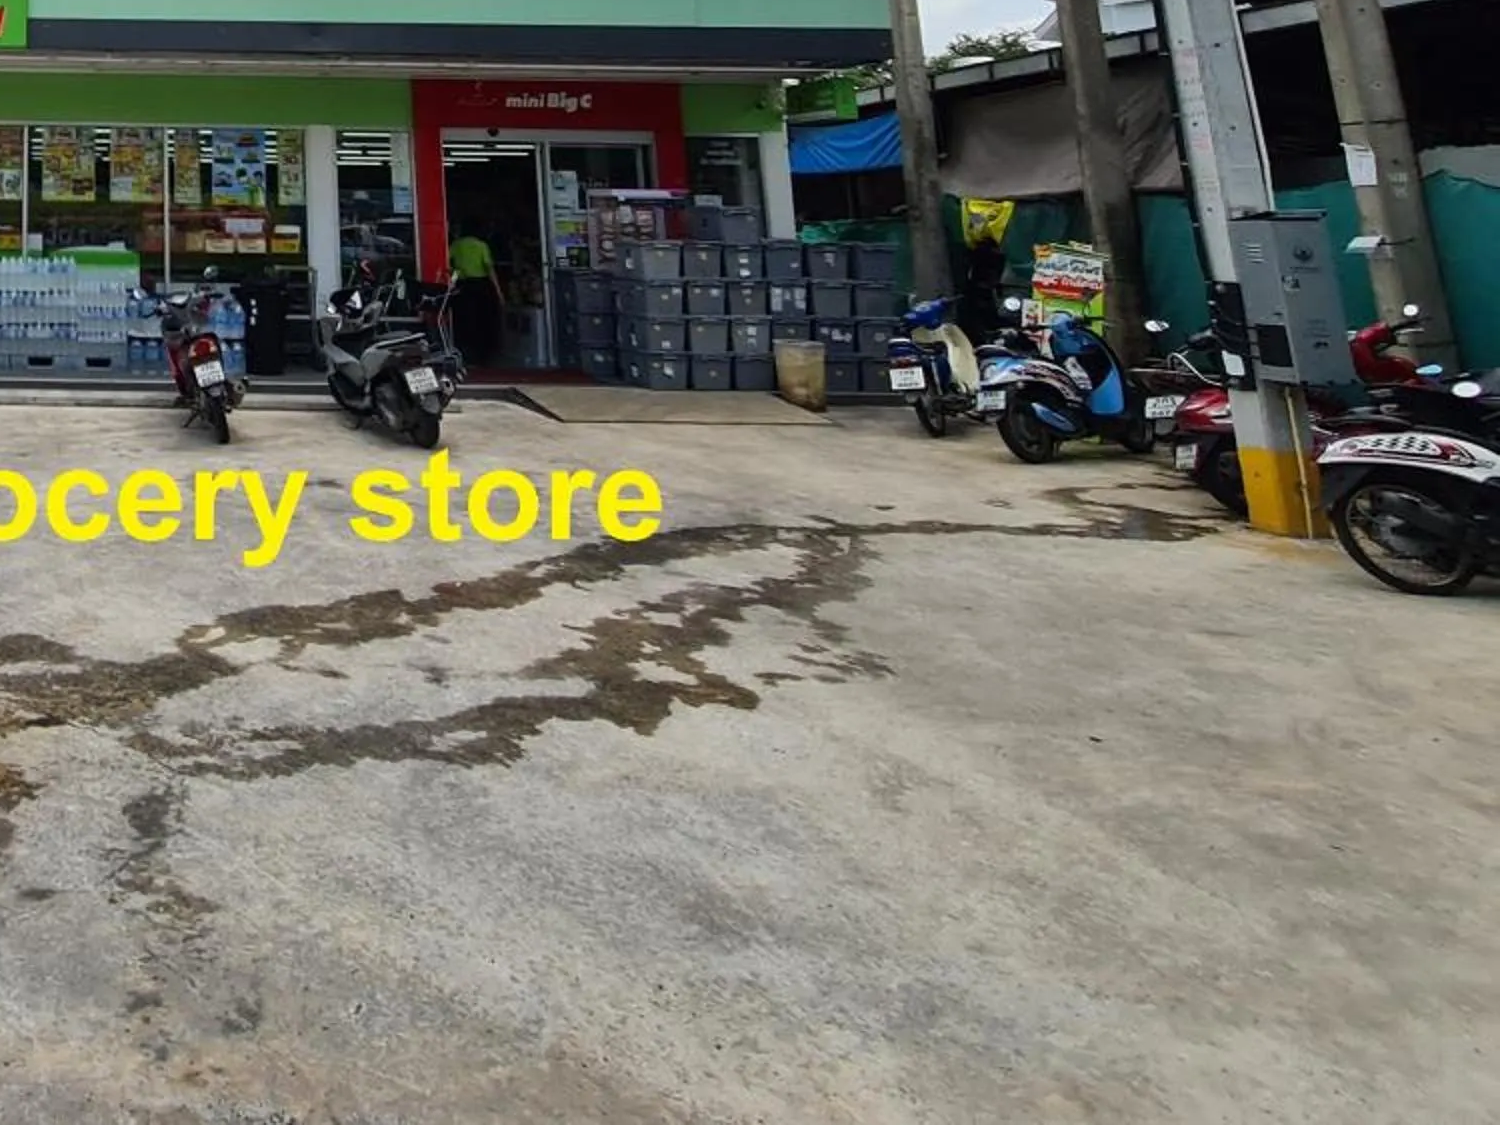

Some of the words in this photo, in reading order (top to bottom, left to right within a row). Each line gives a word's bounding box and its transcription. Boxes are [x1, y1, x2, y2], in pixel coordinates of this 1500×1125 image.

[505, 92, 546, 108] mini
[547, 92, 578, 113] Big
[580, 93, 593, 108] C
